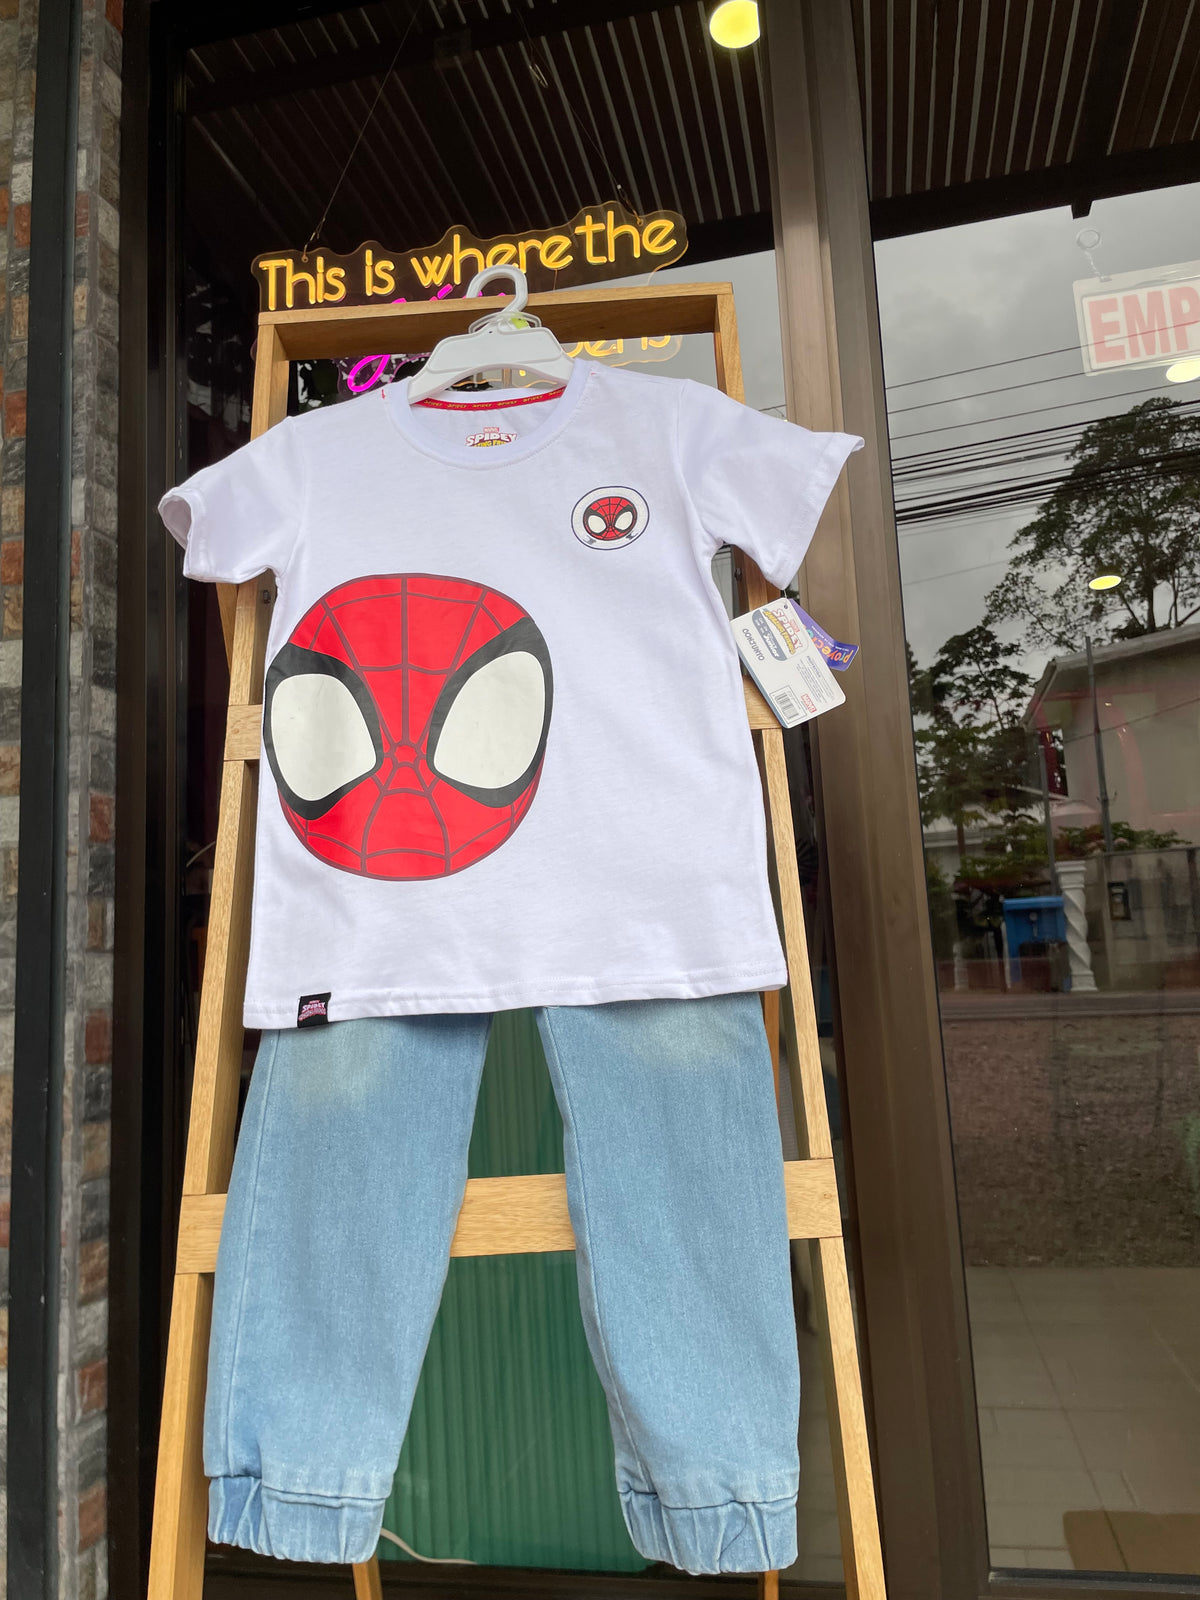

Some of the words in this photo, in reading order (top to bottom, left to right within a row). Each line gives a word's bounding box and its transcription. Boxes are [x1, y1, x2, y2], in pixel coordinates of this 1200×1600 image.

[259, 256, 347, 311] This
[365, 249, 396, 298] is
[411, 233, 574, 288] where
[575, 210, 677, 266] the
[465, 432, 517, 446] SPIDEY
[742, 628, 765, 661] CONJUNTO
[771, 608, 803, 649] SPIDEY
